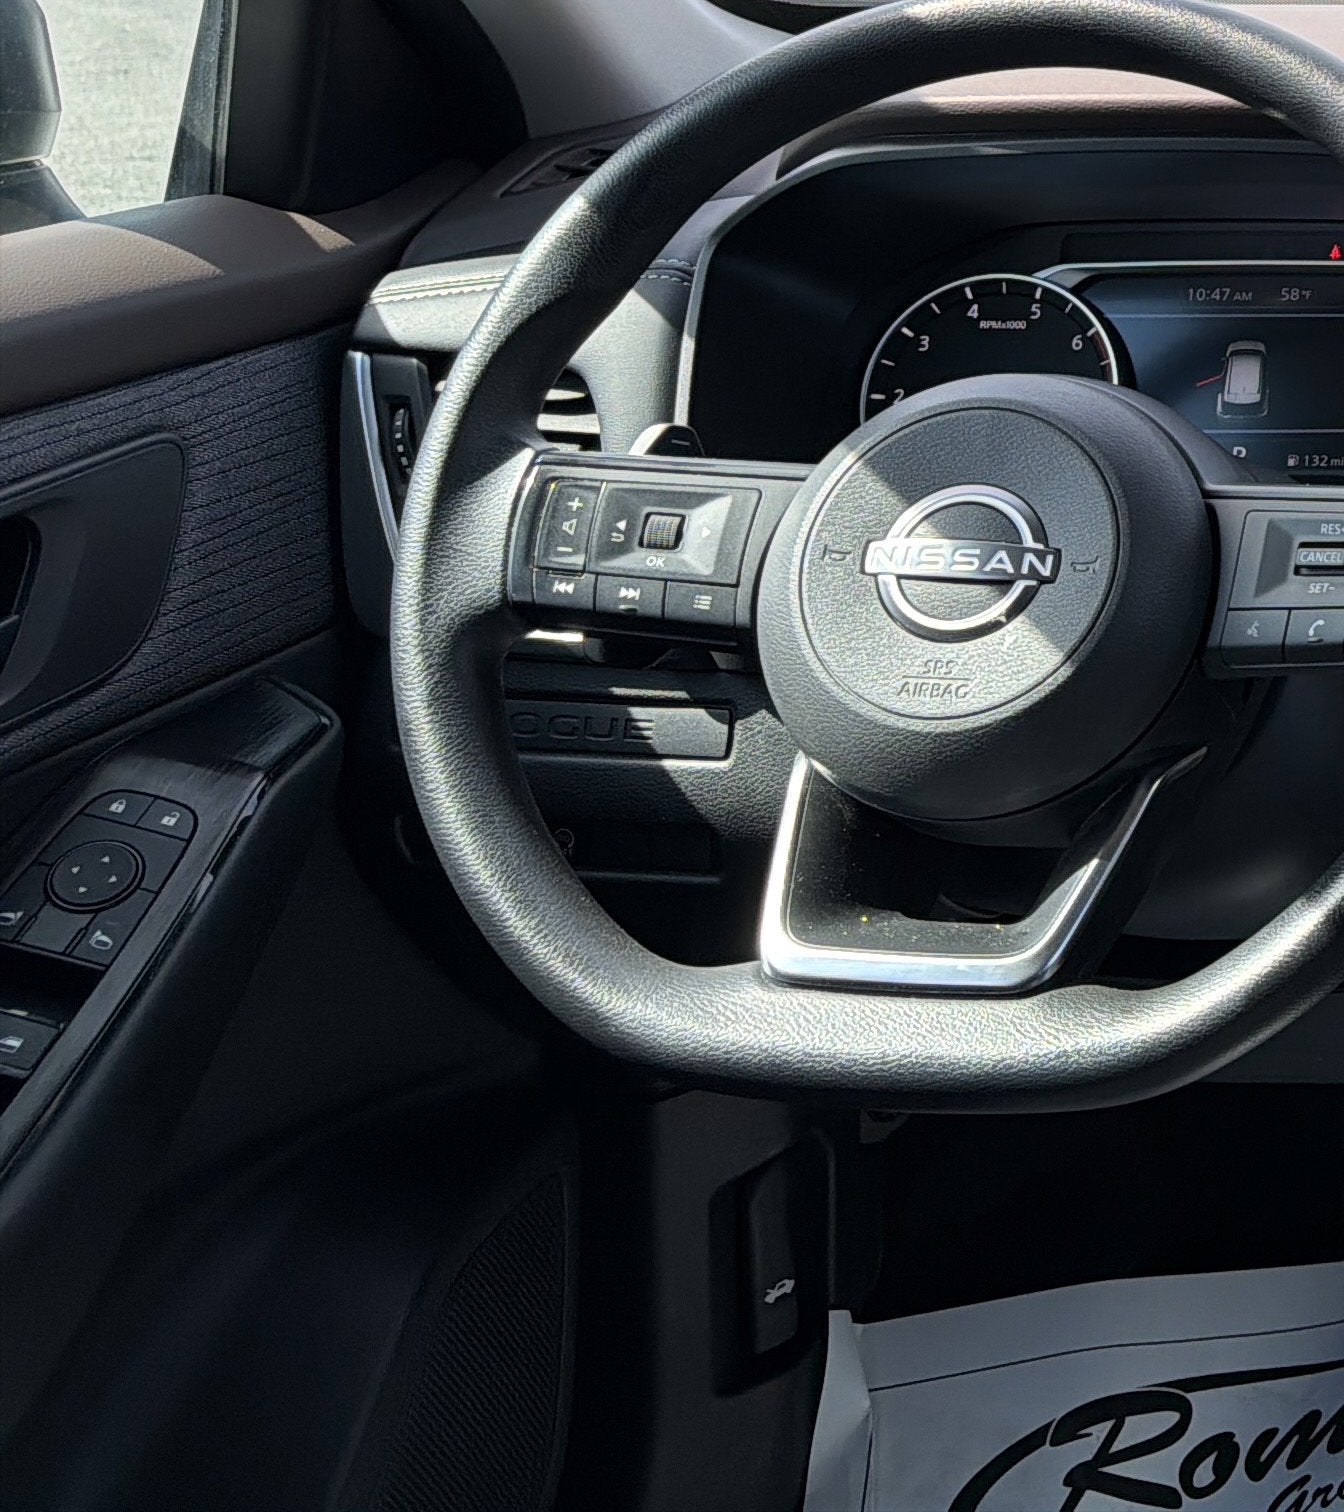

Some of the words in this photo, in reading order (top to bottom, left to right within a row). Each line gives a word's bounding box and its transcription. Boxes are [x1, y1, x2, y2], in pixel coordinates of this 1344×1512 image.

[1187, 287, 1231, 302] 10:47
[1232, 290, 1252, 301] AM
[966, 302, 980, 319] 4
[1029, 303, 1041, 319] 5
[917, 335, 930, 352] 3
[1071, 334, 1083, 351] 6
[892, 388, 905, 405] 2
[1303, 454, 1329, 467] 132
[645, 555, 666, 568] OK
[870, 545, 1055, 578] NISSAN
[1299, 551, 1344, 563] CANCEL
[922, 659, 958, 676] SRS
[896, 681, 973, 699] AIRBAG
